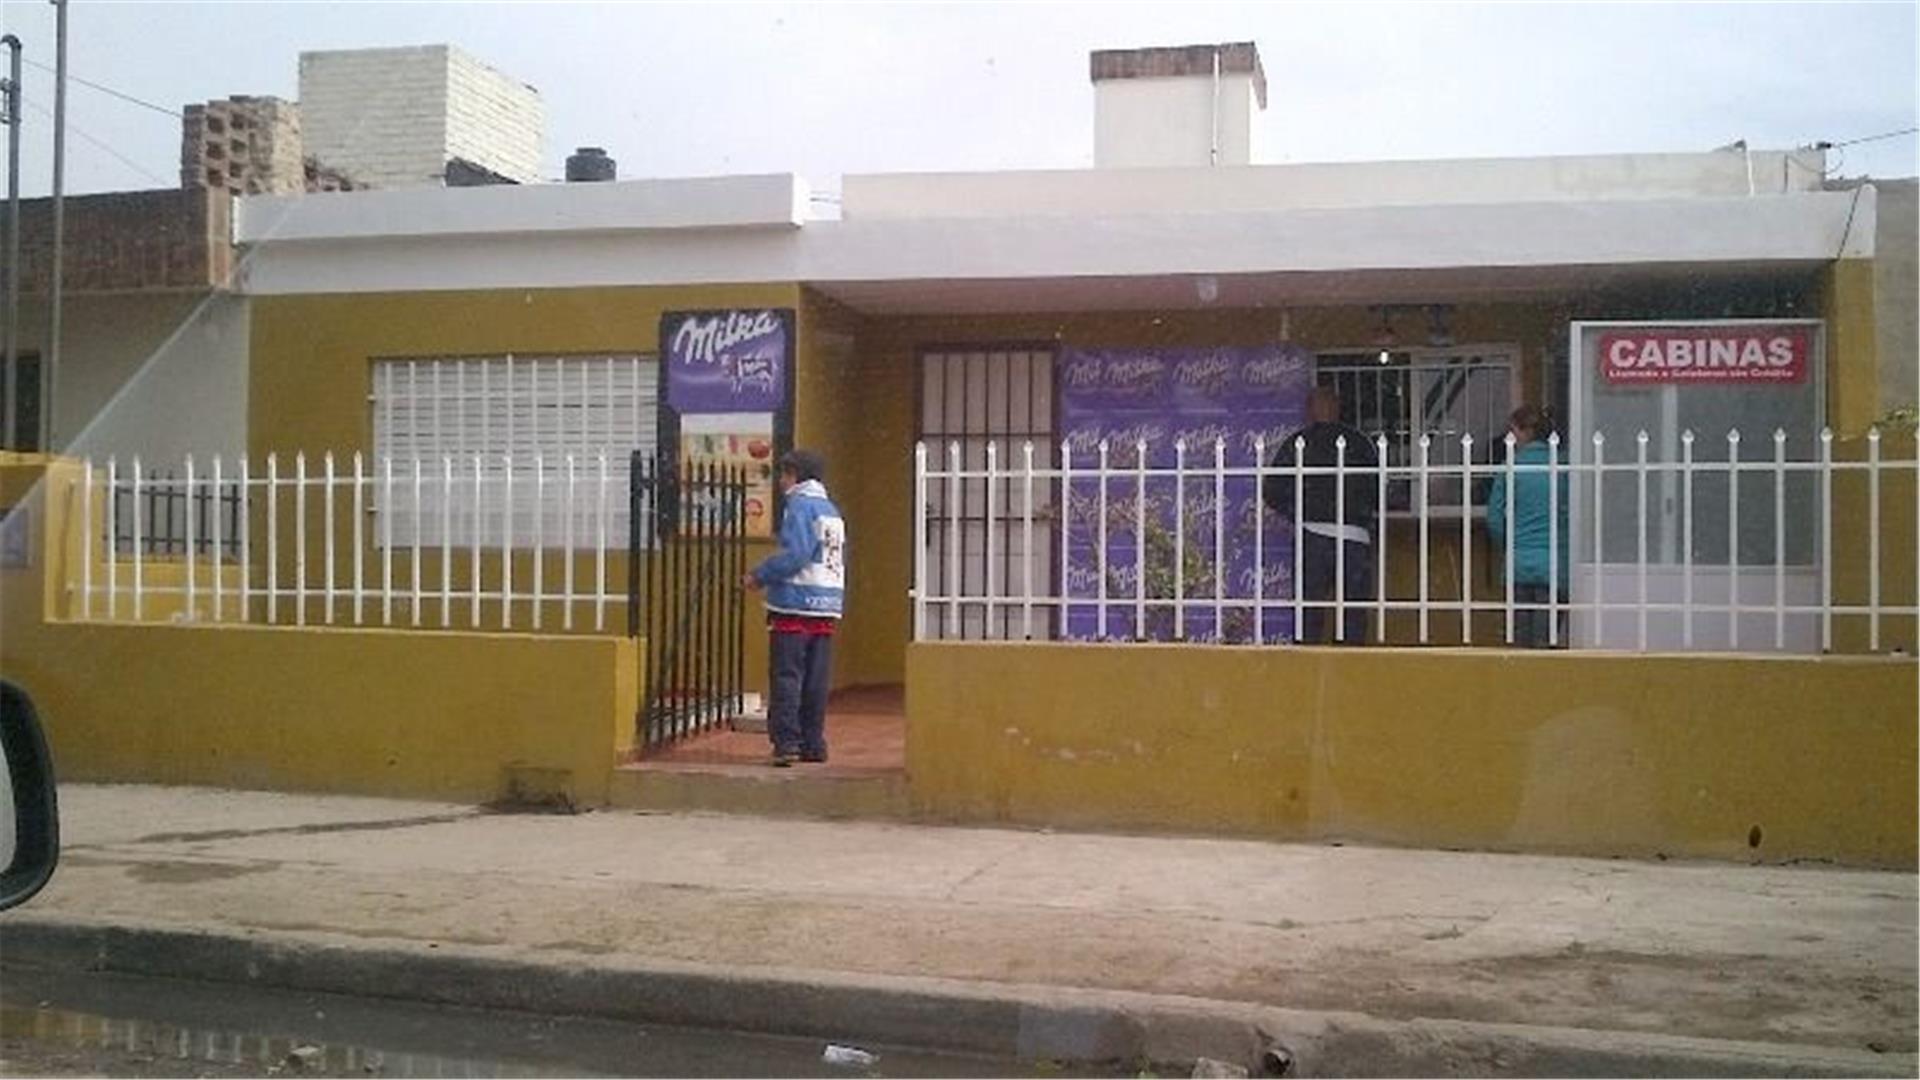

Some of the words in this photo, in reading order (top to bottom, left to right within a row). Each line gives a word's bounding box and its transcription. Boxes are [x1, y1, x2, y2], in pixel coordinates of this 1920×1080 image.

[673, 311, 778, 364] Milka
[1610, 337, 1793, 368] CABINAS
[1242, 356, 1305, 385] Milka
